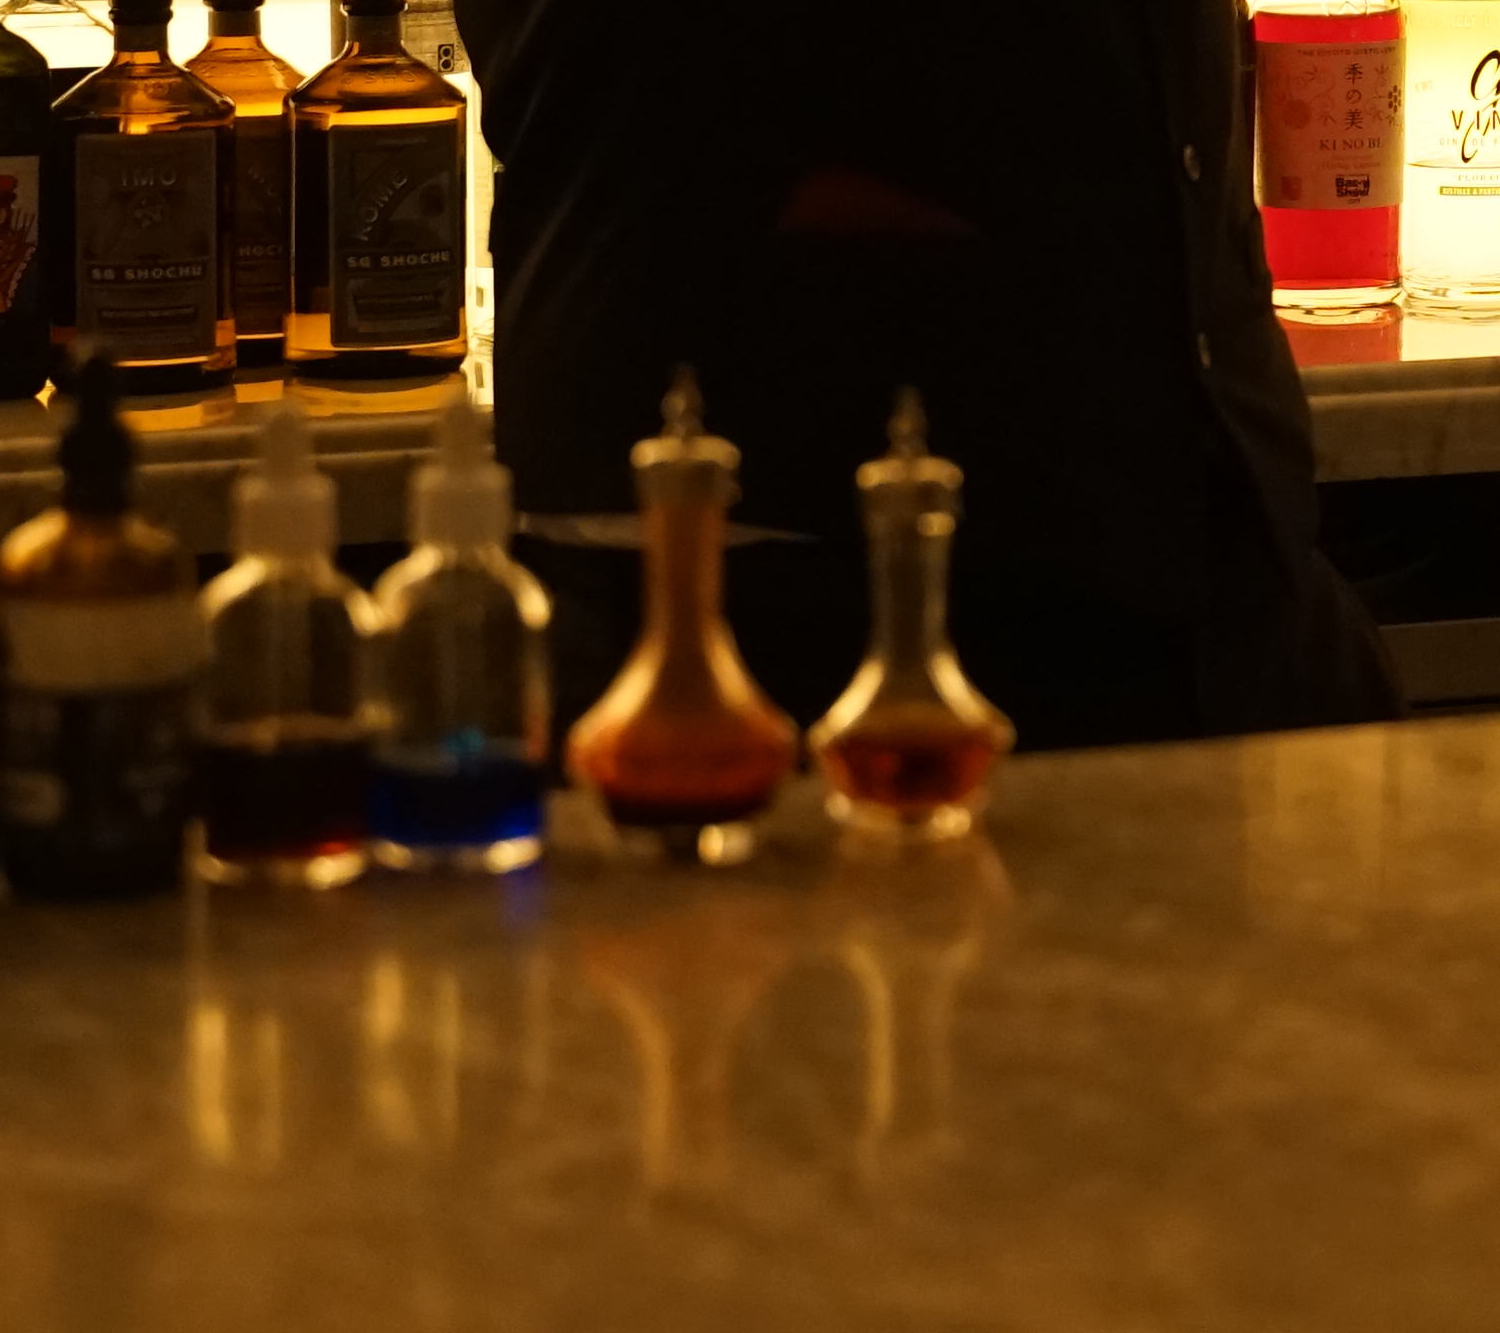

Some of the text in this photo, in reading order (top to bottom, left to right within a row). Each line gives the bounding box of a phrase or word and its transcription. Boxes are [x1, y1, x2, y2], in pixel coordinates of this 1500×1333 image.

[439, 44, 454, 73] 8
[1341, 62, 1365, 131] 季の美
[1341, 137, 1365, 151] NO
[119, 165, 178, 187] IMO
[379, 252, 451, 267] SHOCHU
[124, 267, 202, 280] SHOCHU
